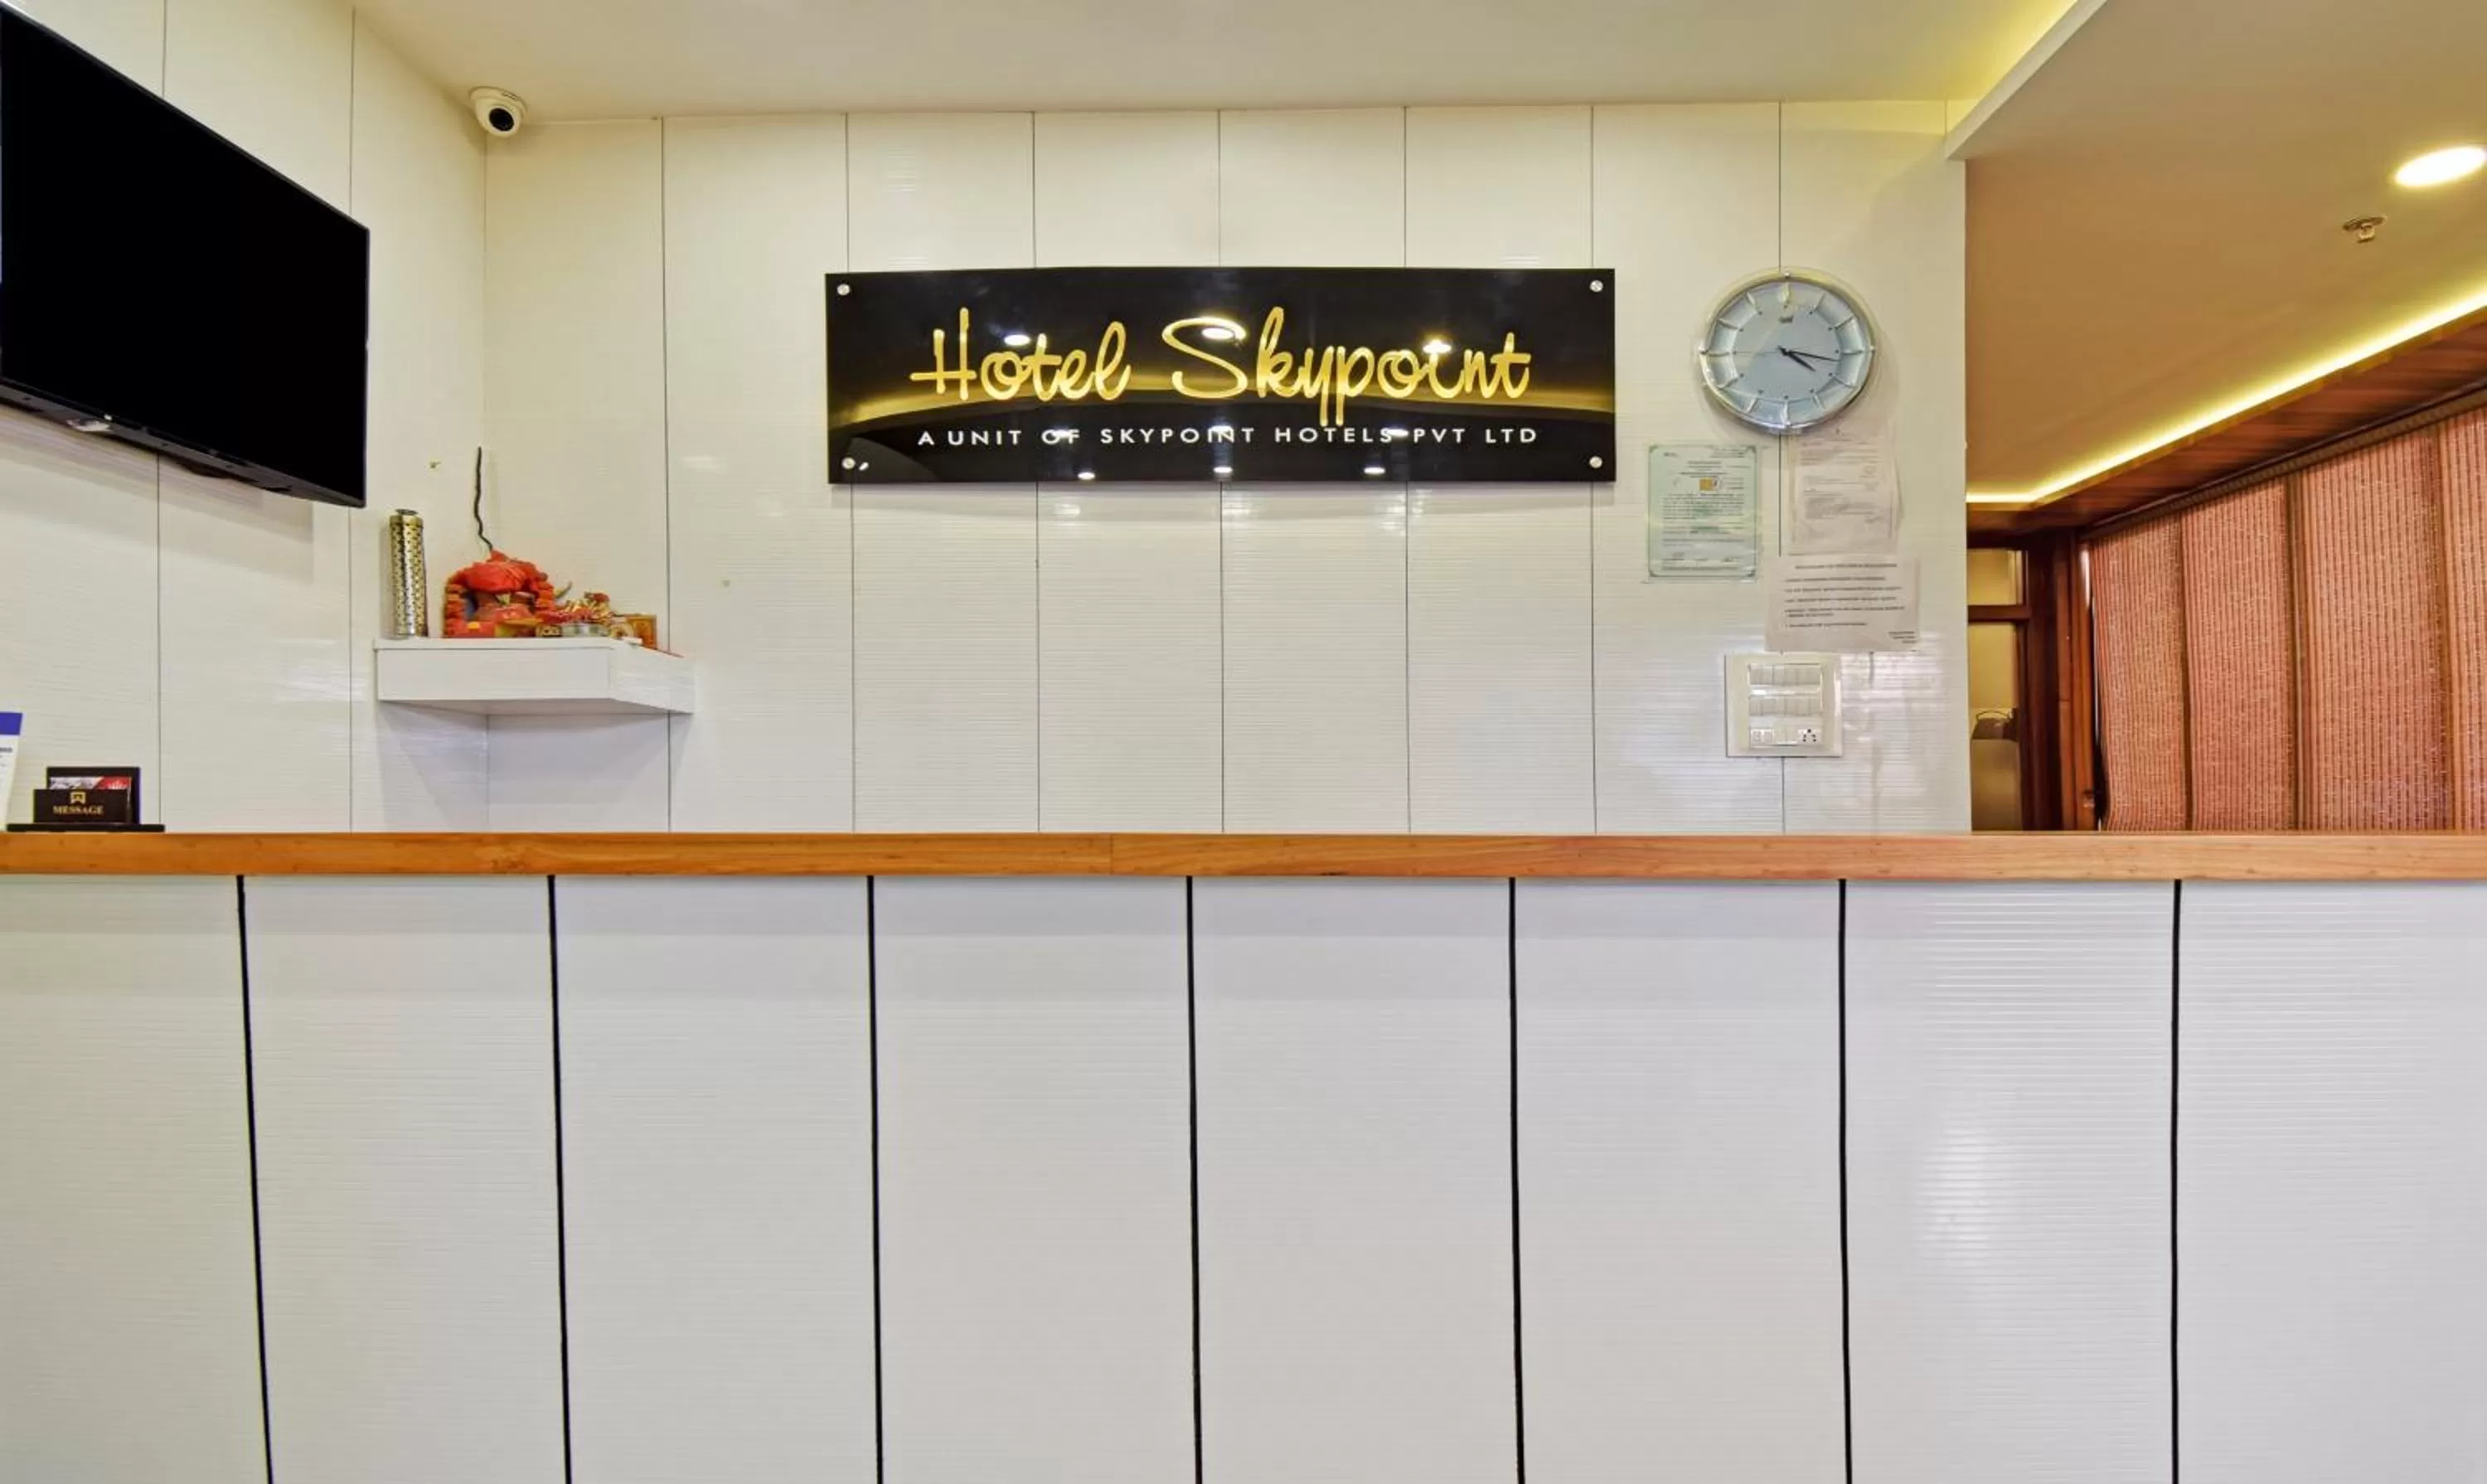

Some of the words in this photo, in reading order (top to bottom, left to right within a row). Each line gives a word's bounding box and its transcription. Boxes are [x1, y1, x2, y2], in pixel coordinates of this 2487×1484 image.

[910, 307, 1131, 401] Hotel
[1161, 305, 1531, 425] Skypoint
[917, 430, 934, 445] A
[948, 430, 1021, 445] UNIT
[1040, 429, 1080, 445] OF
[1100, 427, 1253, 444] SKYPOINT
[1274, 427, 1393, 444] HOTELS
[1413, 428, 1464, 444] PVT
[1486, 428, 1537, 444] LTD
[52, 805, 104, 815] MESSAGE
